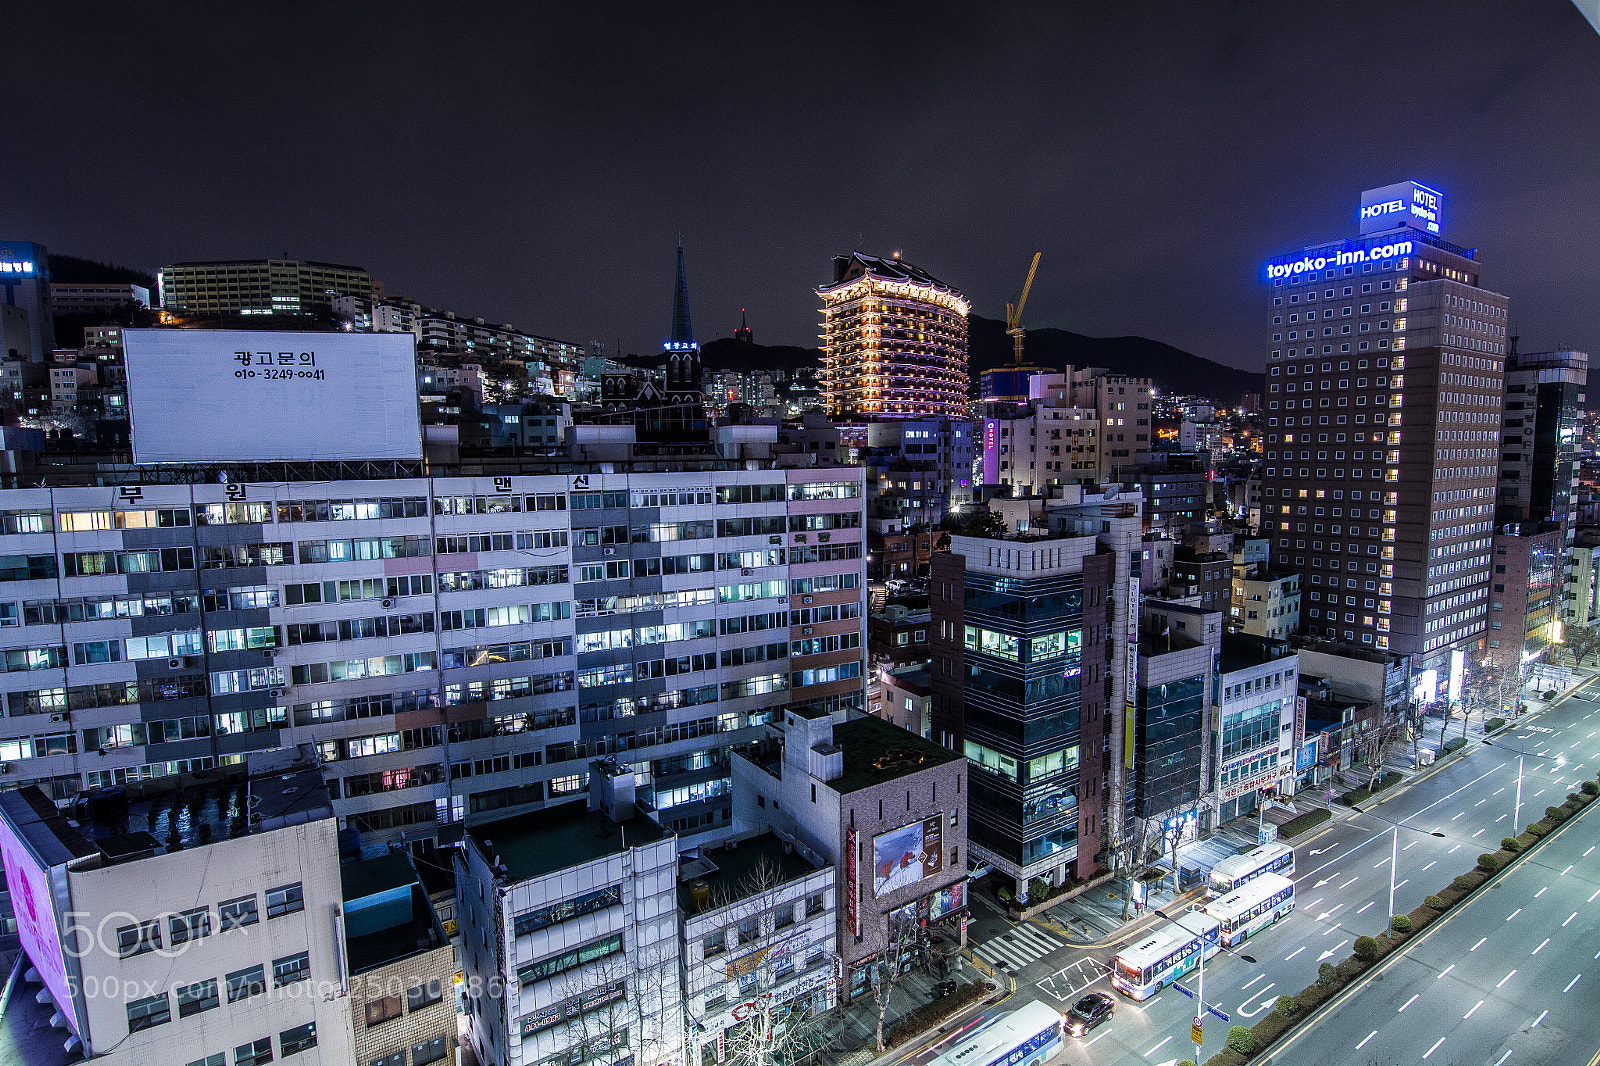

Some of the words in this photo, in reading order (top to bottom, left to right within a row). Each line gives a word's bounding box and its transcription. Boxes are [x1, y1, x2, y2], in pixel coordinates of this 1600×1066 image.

[1361, 199, 1407, 219] HOTEL
[1413, 188, 1438, 211] HOTEL
[1410, 202, 1436, 222] toyoko-inn
[1267, 241, 1413, 279] toyoko-inn.com
[233, 351, 316, 367] 광고문의
[234, 368, 325, 381] 010-3249-0041
